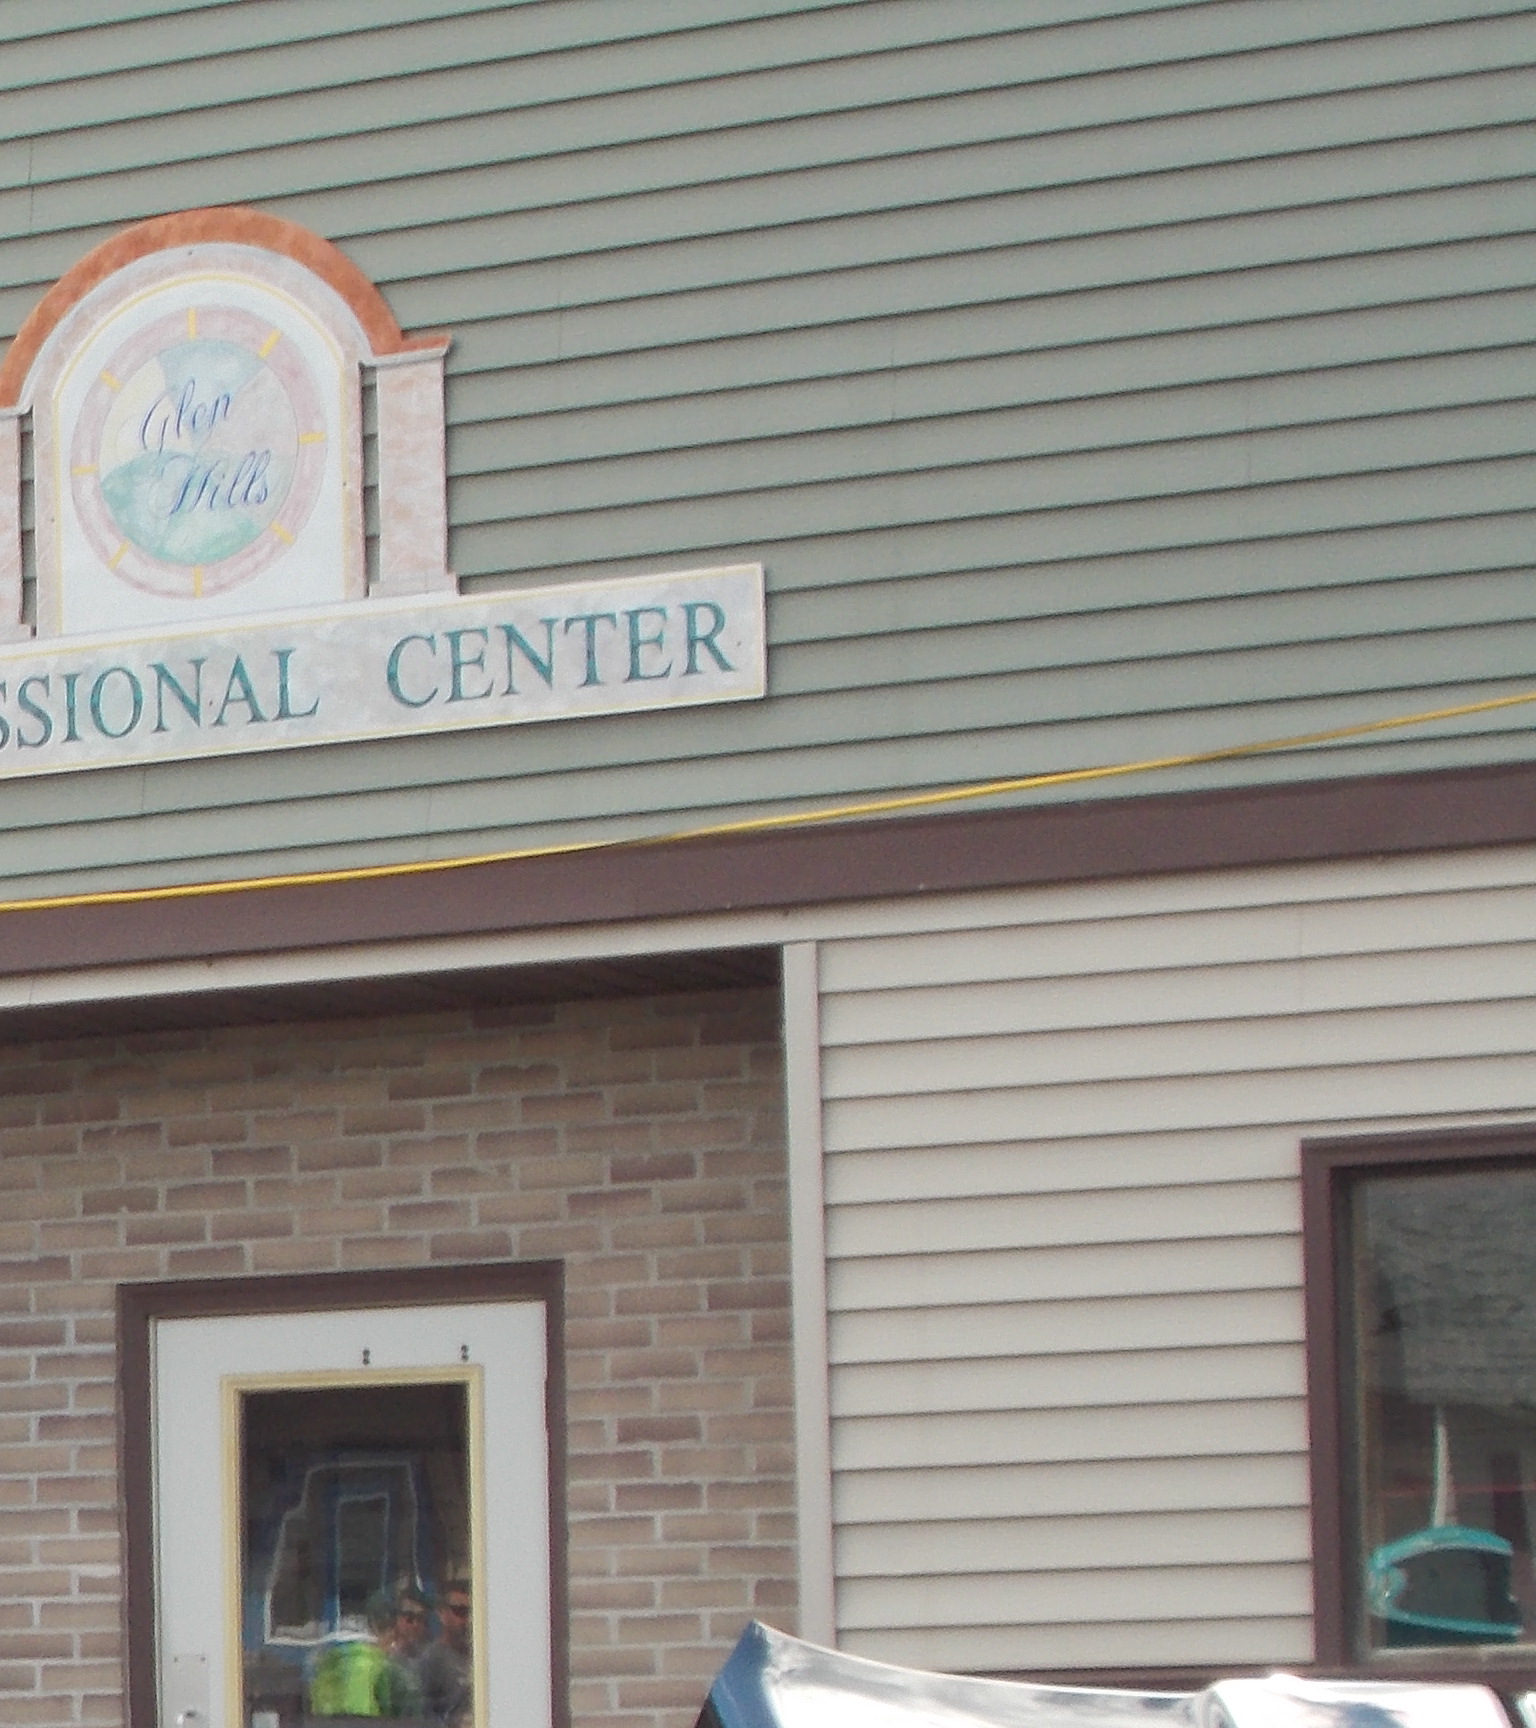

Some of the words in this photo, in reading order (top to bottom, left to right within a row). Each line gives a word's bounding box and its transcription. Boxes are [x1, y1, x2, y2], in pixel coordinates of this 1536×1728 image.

[131, 378, 230, 460] Glen
[150, 449, 272, 519] Hills
[386, 600, 736, 710] CENTER
